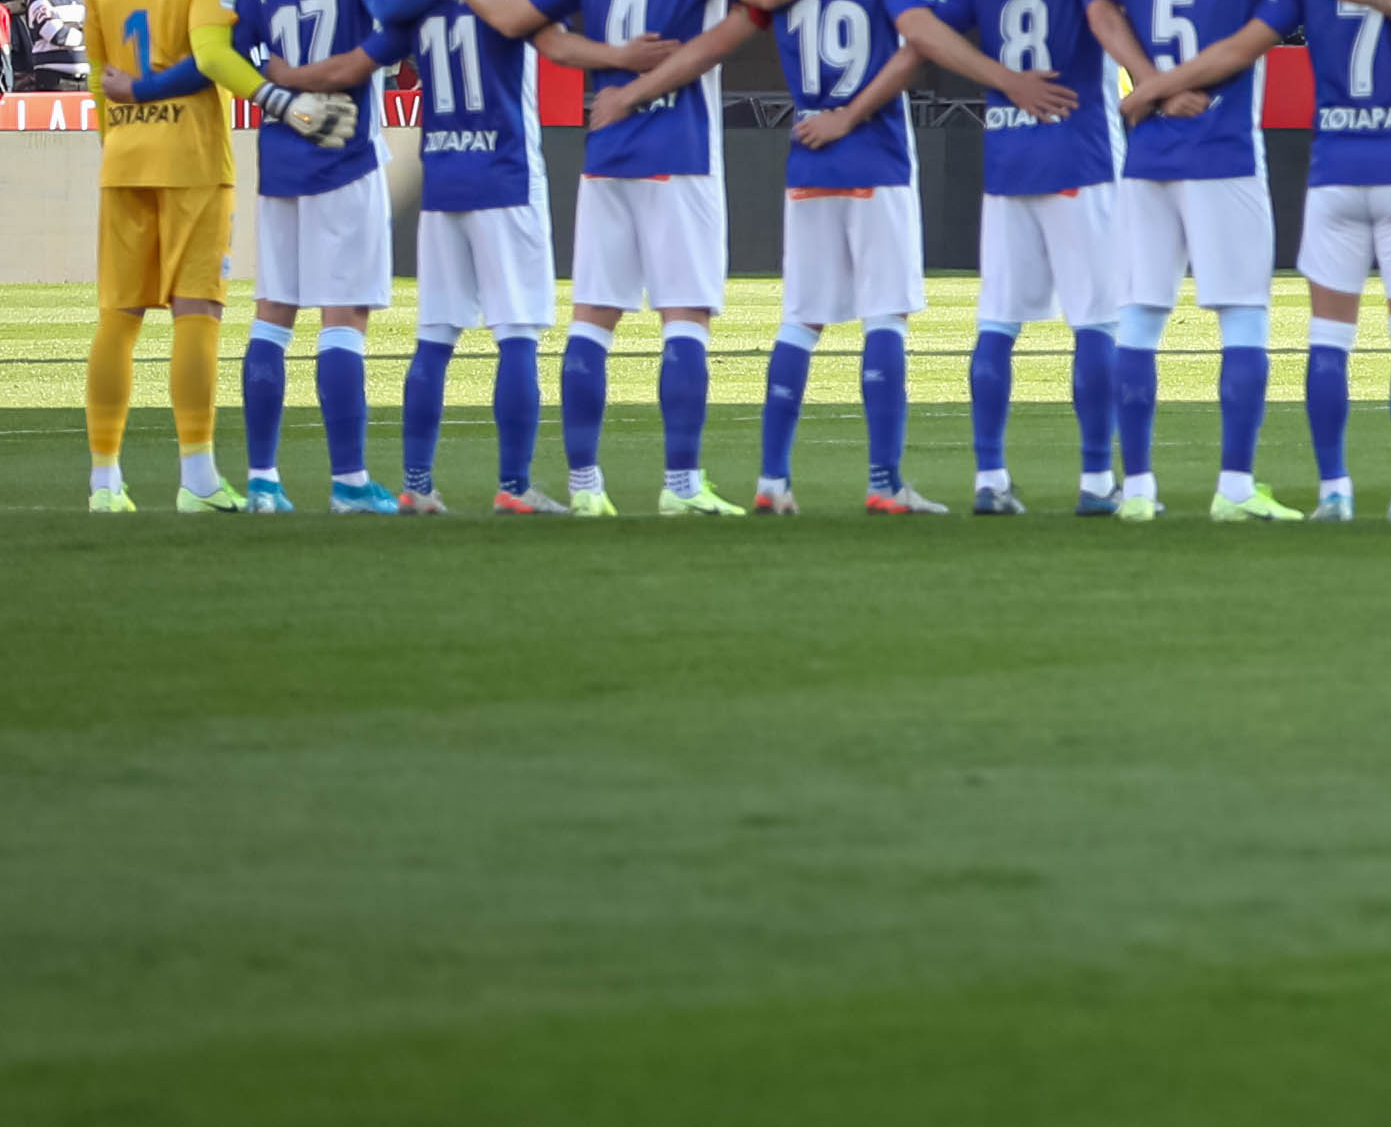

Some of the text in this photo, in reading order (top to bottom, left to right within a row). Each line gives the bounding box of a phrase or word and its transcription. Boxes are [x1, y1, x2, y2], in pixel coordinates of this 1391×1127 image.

[121, 8, 151, 79] 1
[419, 15, 485, 115] 11
[1336, 0, 1385, 98] 7
